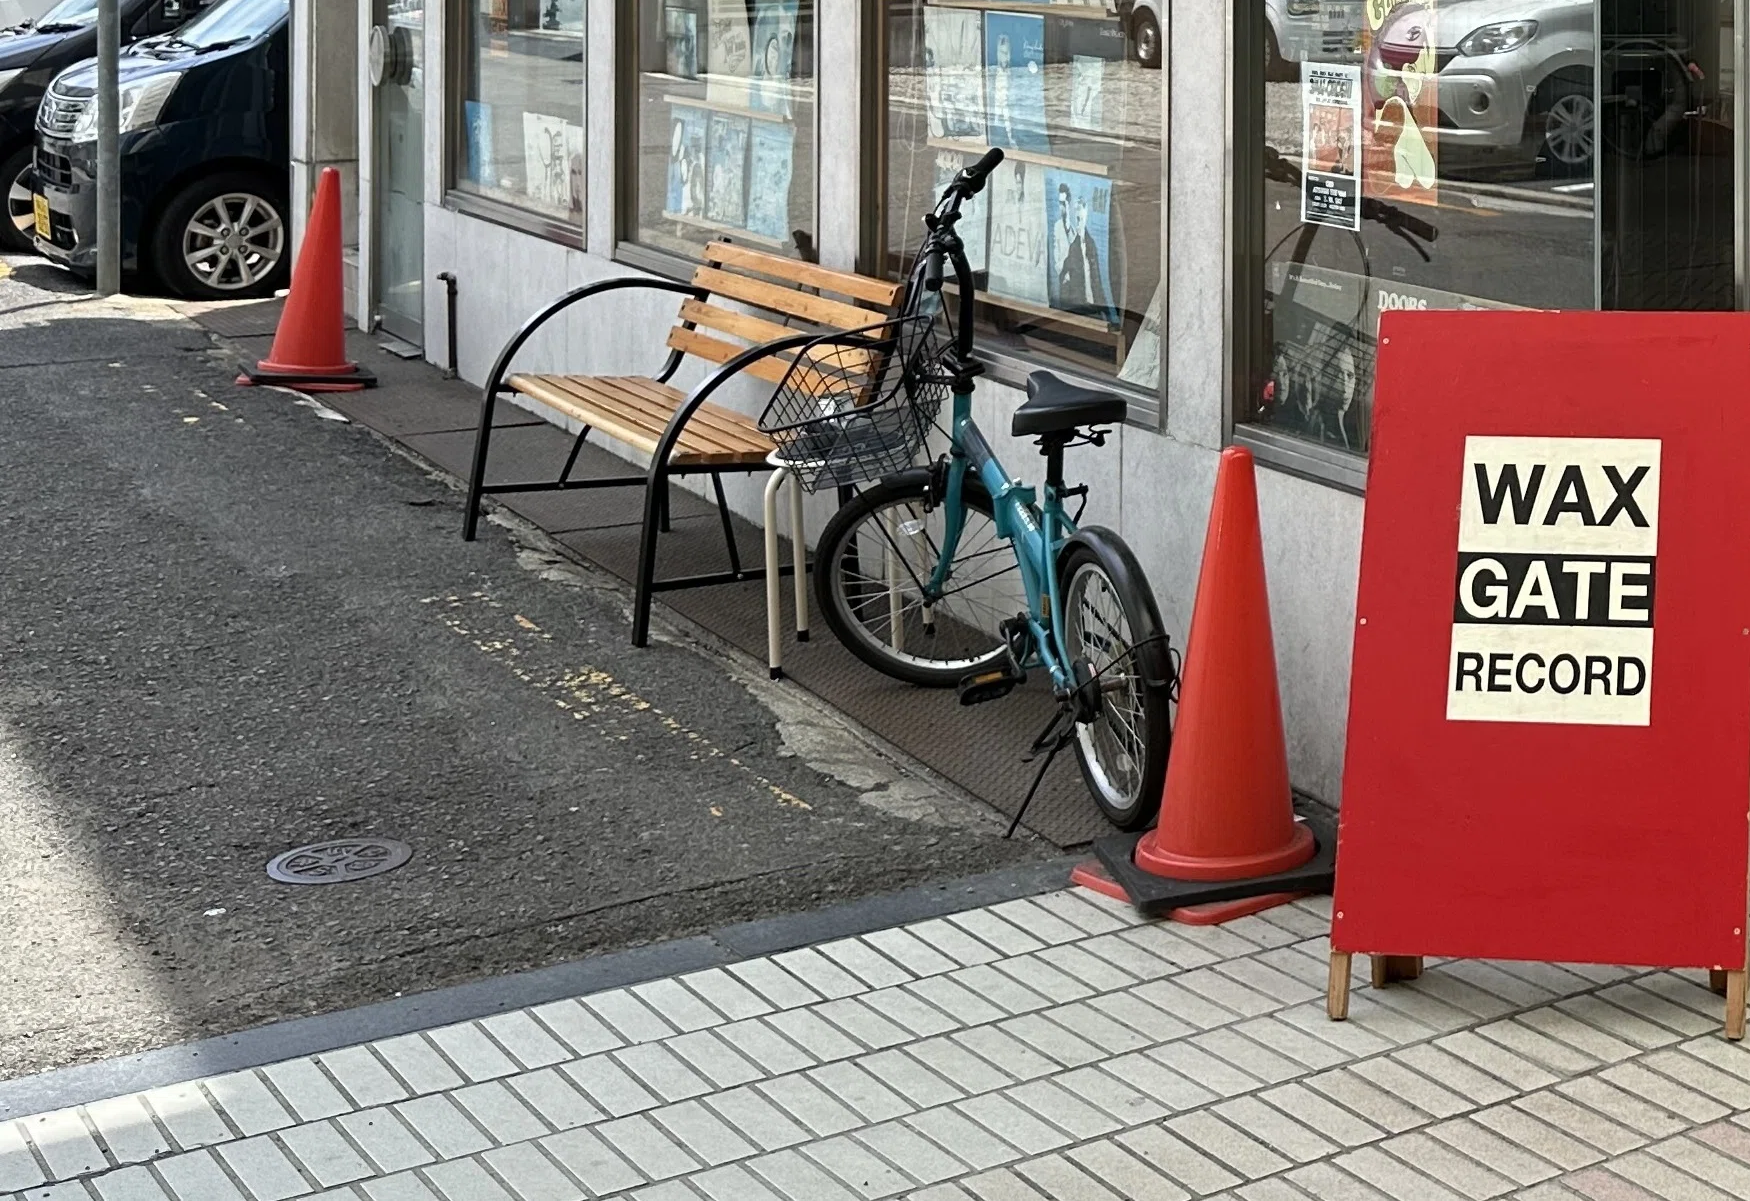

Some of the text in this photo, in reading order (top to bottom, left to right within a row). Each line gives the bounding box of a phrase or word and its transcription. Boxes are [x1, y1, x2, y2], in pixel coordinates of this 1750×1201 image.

[1377, 290, 1427, 310] DOORS
[1473, 463, 1650, 527] WAX
[1459, 558, 1650, 621] GATE
[1455, 651, 1646, 696] RECORD
